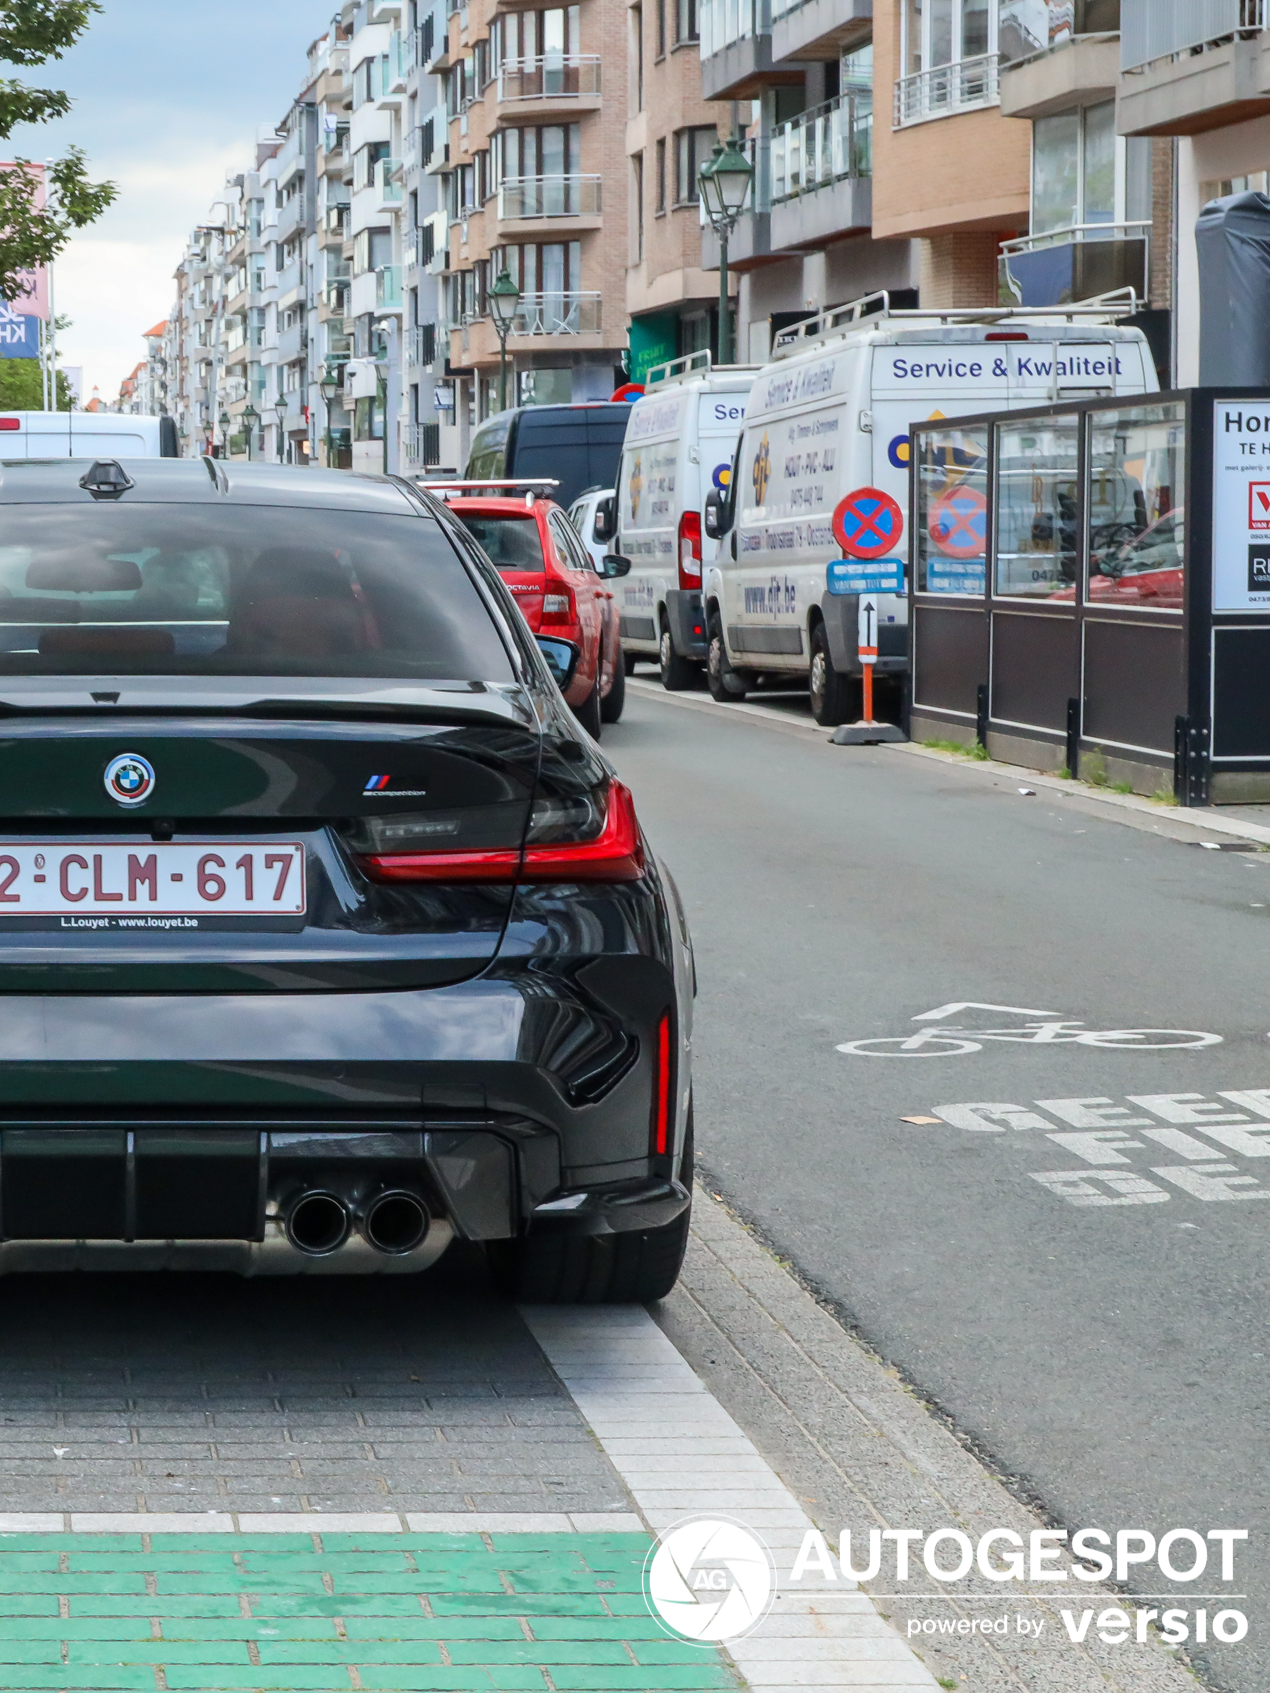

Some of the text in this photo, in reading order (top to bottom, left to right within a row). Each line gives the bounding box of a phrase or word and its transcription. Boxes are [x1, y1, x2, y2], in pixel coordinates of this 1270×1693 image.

[892, 356, 1123, 378] Service & Kwaliteit
[1239, 442, 1256, 455] TE
[744, 574, 796, 620] www.djt.be
[60, 917, 109, 929] L.Louyet
[118, 917, 198, 929] www.louyet.be
